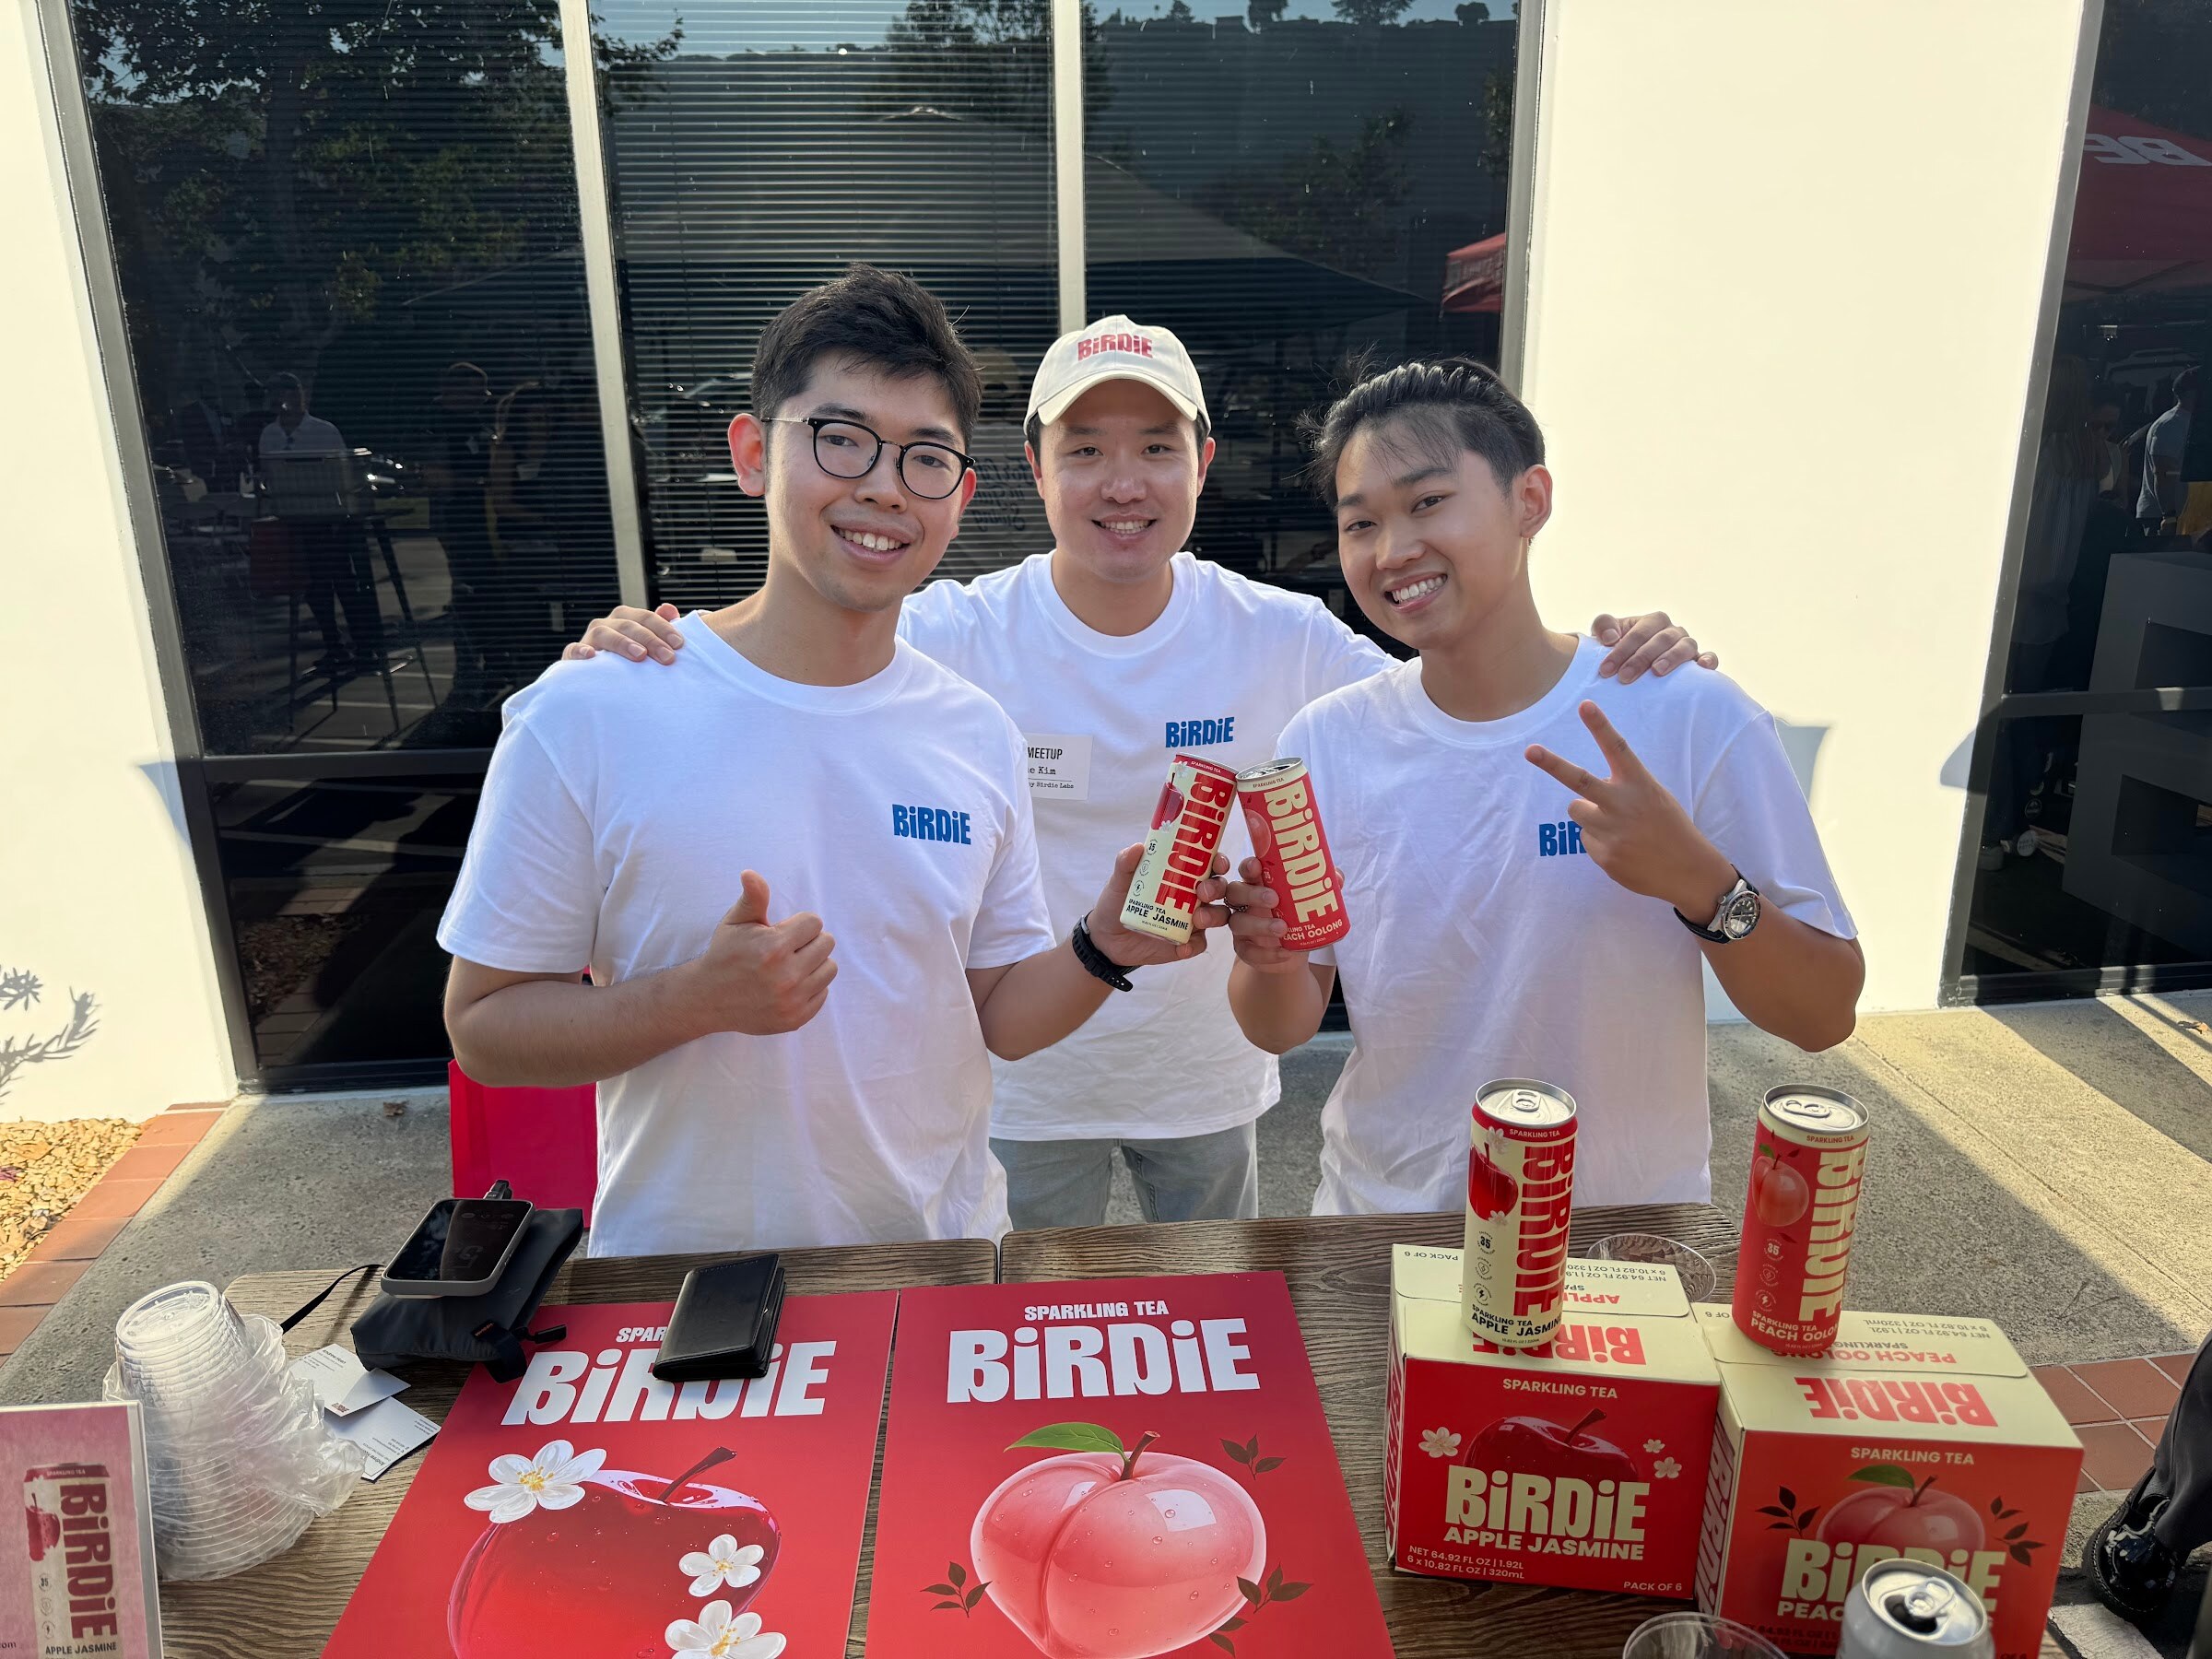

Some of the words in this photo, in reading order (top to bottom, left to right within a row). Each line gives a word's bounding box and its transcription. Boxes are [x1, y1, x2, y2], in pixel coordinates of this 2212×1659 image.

[1165, 716, 1235, 748] BiRDiE
[1038, 766, 1056, 775] Kim
[891, 804, 971, 845] BiRDiE
[1539, 820, 1587, 857] BiR
[1264, 780, 1339, 923] BiRDiE
[1125, 904, 1149, 918] APPLE
[1152, 913, 1190, 930] JASMINE
[1128, 898, 1154, 911] SPARKLING
[1155, 906, 1166, 915] TEA
[1283, 932, 1305, 941] EACH
[1307, 919, 1343, 938] OOLONG
[1509, 1128, 1548, 1138] SPARKLING
[1806, 1135, 1843, 1143] SPARKLING
[1480, 1235, 1491, 1249] 35
[1767, 1242, 1780, 1255] 35
[1430, 1253, 1459, 1261] PACK
[1024, 1300, 1130, 1322] SPARKLING
[1134, 1300, 1170, 1317] TEA
[1472, 1304, 1514, 1325] SPARKLING
[1752, 1311, 1798, 1331] SPARKLING
[1471, 1312, 1509, 1335] APPLE
[1516, 1312, 1562, 1336] JASMIN
[1751, 1317, 1798, 1342] PEACH
[1802, 1322, 1840, 1342] OOLO
[1936, 1330, 1967, 1338] 64.92
[1941, 1323, 1969, 1331] 10.82
[947, 1317, 1261, 1404] BiRDiE
[1875, 1350, 1958, 1364] PEACH
[1502, 1378, 1586, 1396] SPARKLING
[1589, 1385, 1618, 1399] TEA
[1850, 1447, 1941, 1464] SPARKLING
[1945, 1452, 1975, 1465] TEA
[1445, 1465, 1651, 1541] BiRDiE
[1443, 1526, 1523, 1551] APPLE
[1527, 1536, 1645, 1560] JASMINE
[59, 1482, 118, 1640] BiRDiE
[1406, 1555, 1415, 1563] 6
[1424, 1559, 1452, 1571] 10.82
[1453, 1565, 1464, 1573] FL
[1465, 1566, 1481, 1575] OZ
[1488, 1568, 1525, 1579] 320mL
[1409, 1545, 1430, 1557] NET
[1430, 1550, 1461, 1563] 64.92
[1463, 1556, 1474, 1565] FL
[1476, 1557, 1491, 1566] OZ
[1499, 1559, 1524, 1570] 1.92L
[1623, 1581, 1655, 1591] PACK
[1657, 1583, 1674, 1591] OF
[1675, 1583, 1683, 1592] 6
[1777, 1600, 1844, 1621] PEAC
[45, 1645, 73, 1655] APPLE
[75, 1641, 117, 1654] JASMINE
